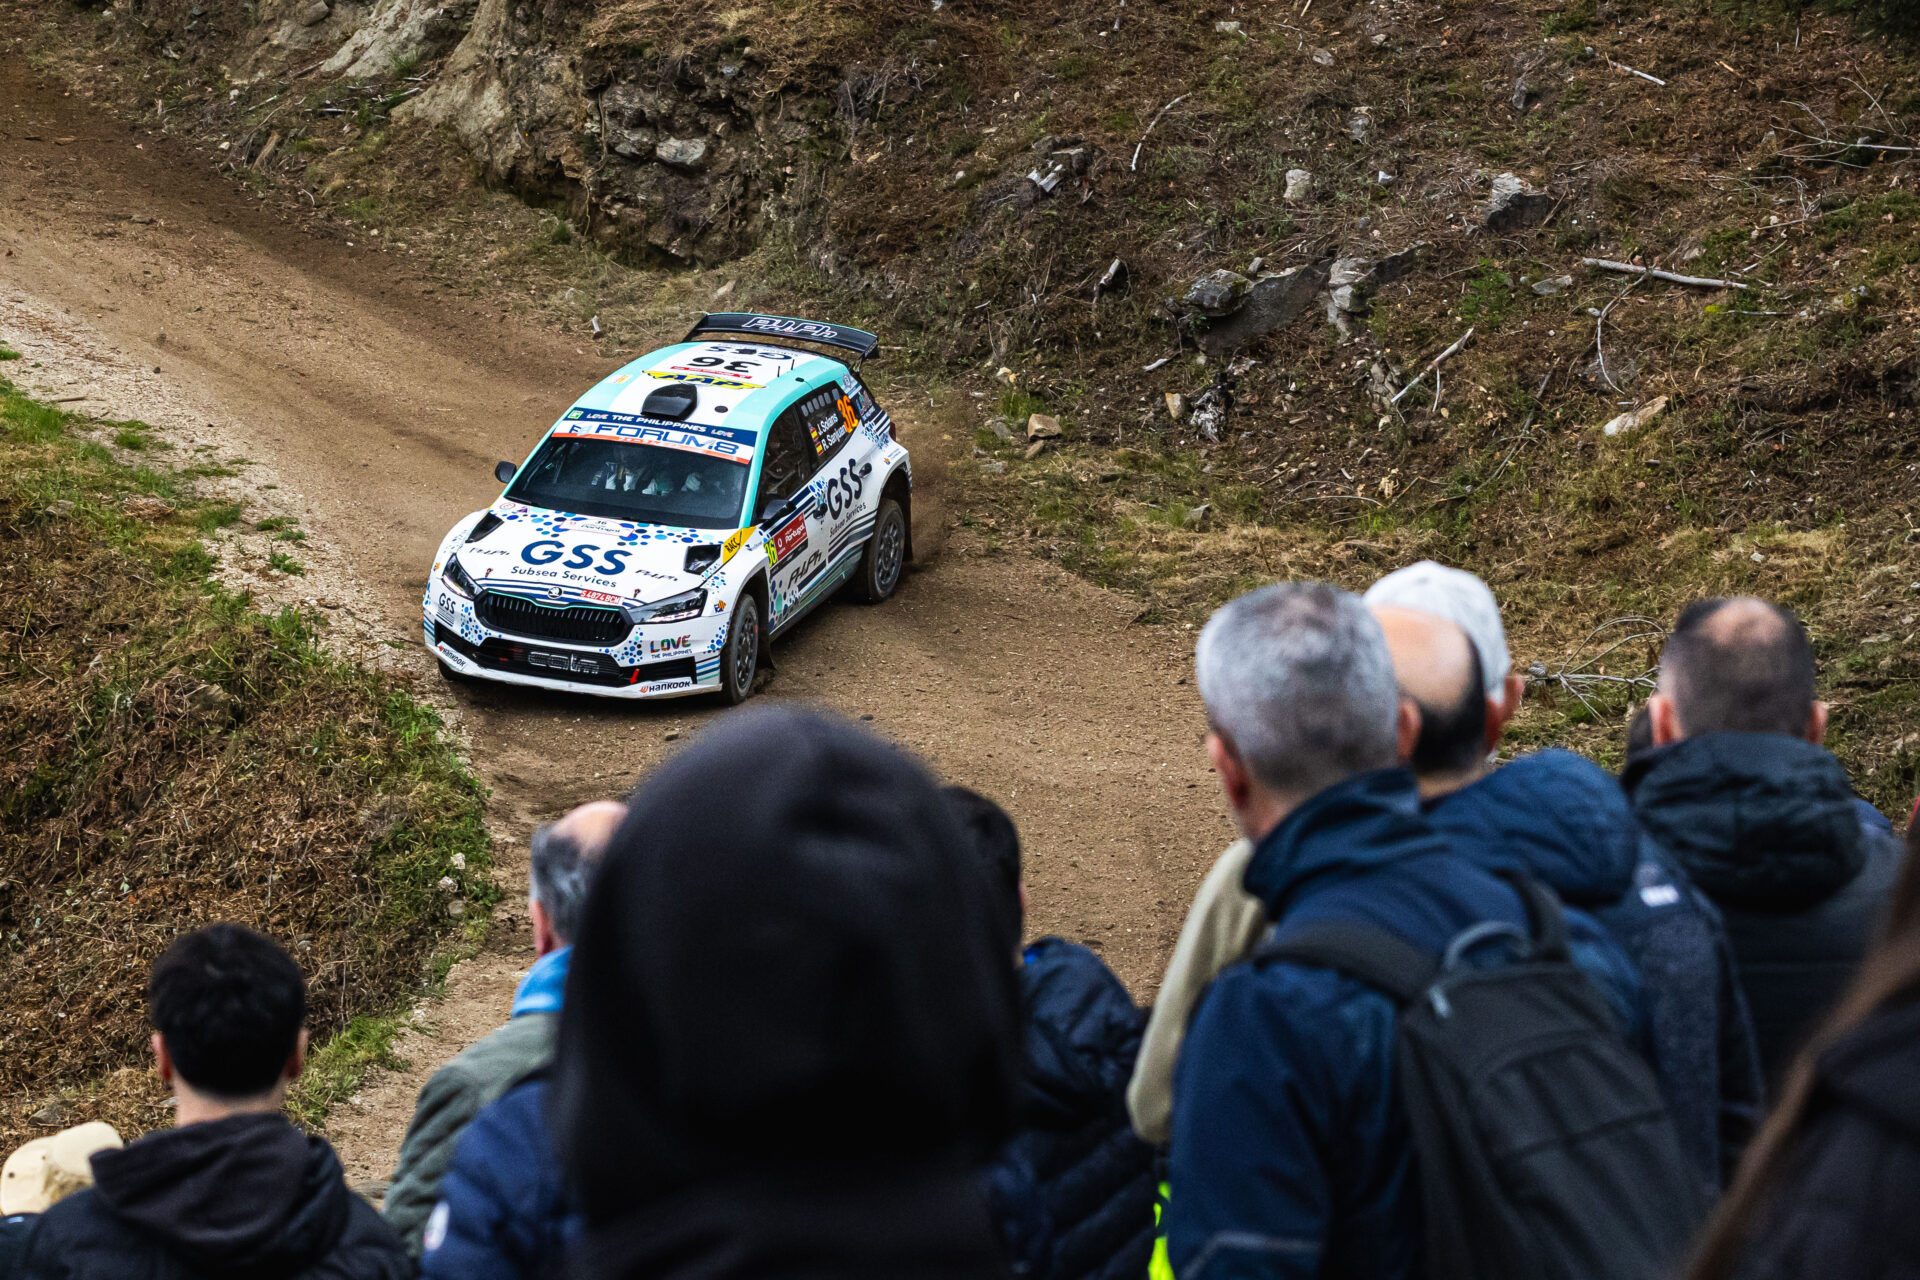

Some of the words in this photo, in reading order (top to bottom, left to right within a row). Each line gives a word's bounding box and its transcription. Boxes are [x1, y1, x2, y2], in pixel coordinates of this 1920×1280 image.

[686, 356, 762, 373] 36
[612, 414, 633, 423] THE
[635, 416, 707, 433] PHILIPPINES
[837, 395, 859, 434] 36
[595, 424, 739, 455] FORUM8
[827, 458, 862, 520] GSS
[846, 502, 866, 522] Services
[785, 524, 805, 543] Portugal
[725, 537, 740, 553] RACC
[764, 539, 777, 568] 36
[521, 540, 633, 576] GSS
[511, 565, 557, 578] Subsea
[562, 570, 617, 588] Services
[439, 593, 456, 614] GSS
[650, 635, 691, 653] LOVE
[662, 649, 692, 658] PHILIPPINES
